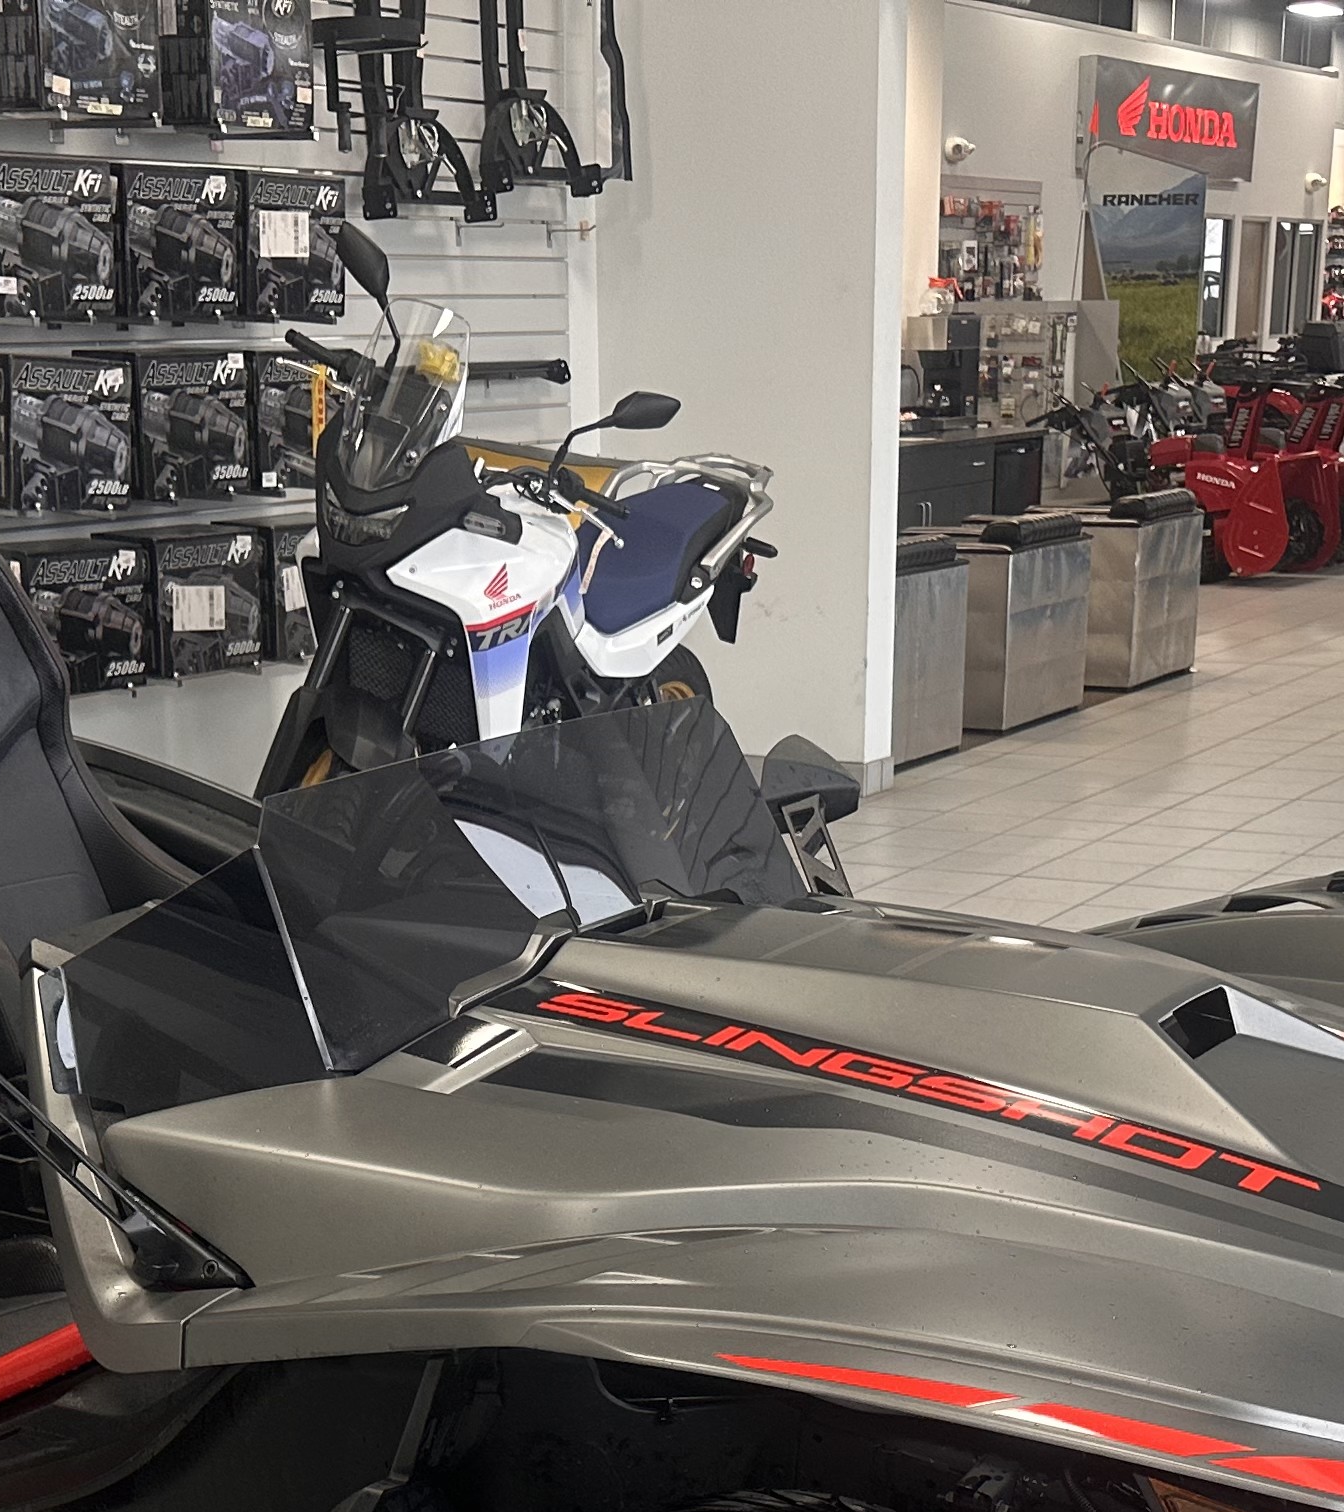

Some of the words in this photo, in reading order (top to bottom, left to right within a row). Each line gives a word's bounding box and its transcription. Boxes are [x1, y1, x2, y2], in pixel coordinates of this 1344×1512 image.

[1146, 101, 1238, 148] HONDA
[127, 172, 201, 200] ASSAULT
[250, 178, 317, 207] ASSAULT
[1102, 193, 1201, 207] RANCHER
[11, 361, 96, 393] ASSAULT
[141, 360, 214, 387] ASSAULT
[1195, 471, 1236, 490] HONDA
[159, 543, 229, 571] ASSAULT
[30, 557, 110, 586] ASSAULT
[488, 593, 522, 611] HONDA
[535, 991, 1322, 1195] SLINGSHOT
